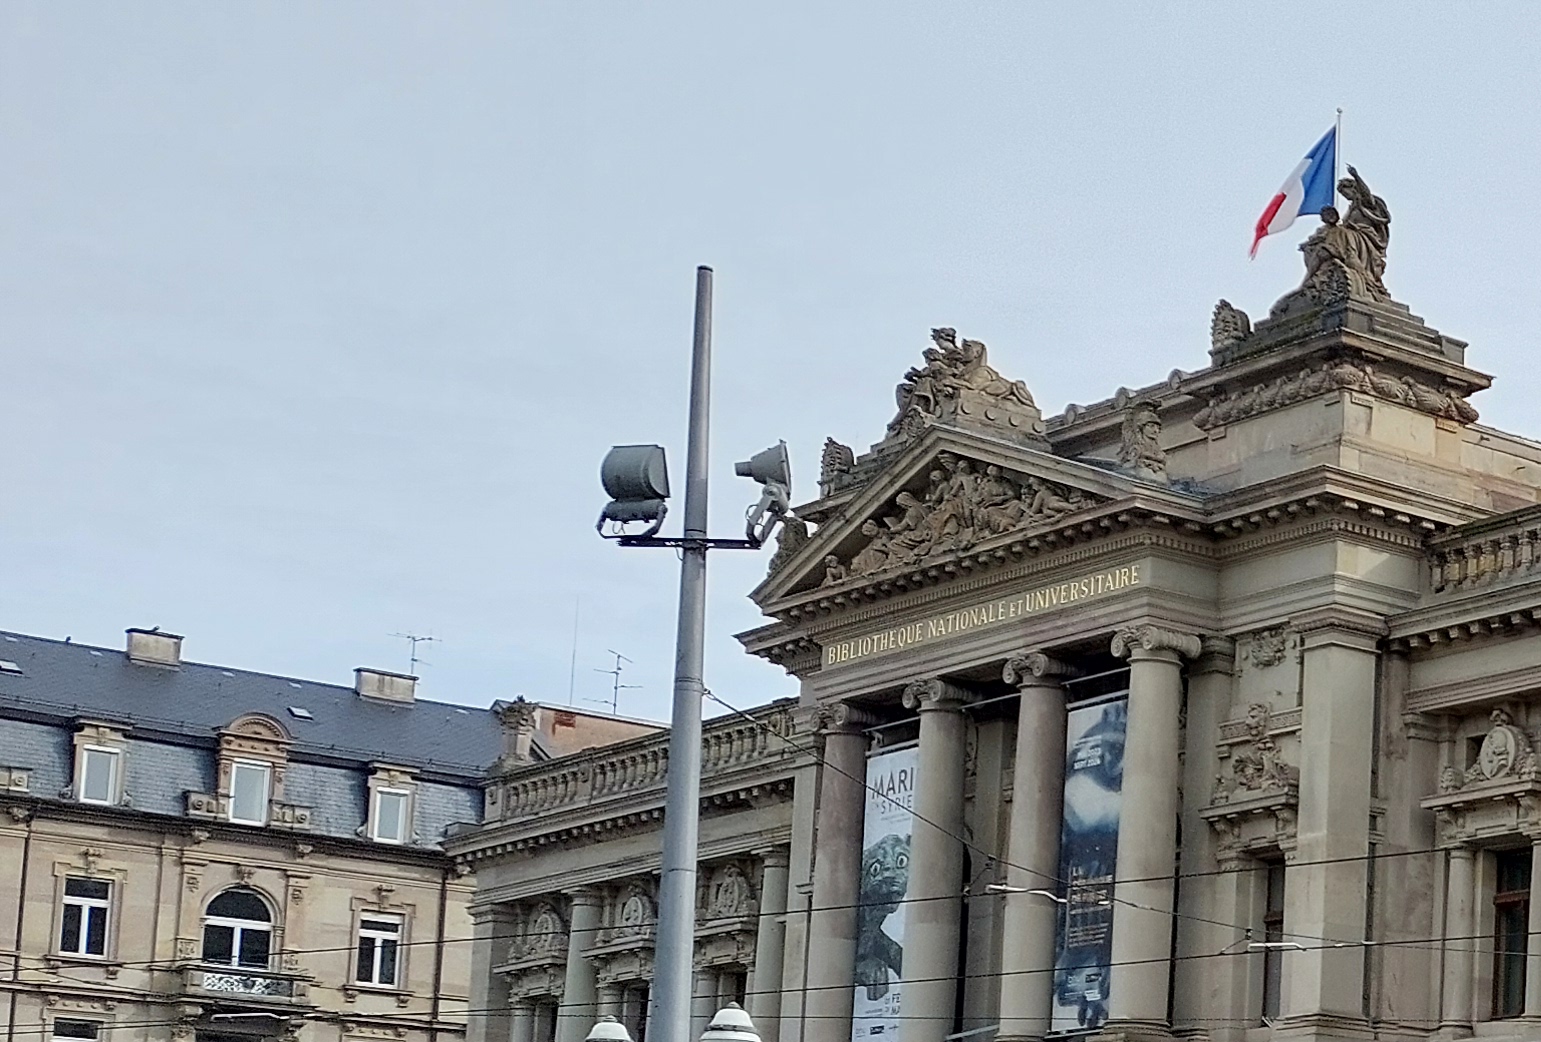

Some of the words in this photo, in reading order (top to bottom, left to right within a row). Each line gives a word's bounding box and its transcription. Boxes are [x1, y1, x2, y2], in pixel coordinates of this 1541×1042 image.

[927, 601, 1006, 638] NATIONALE
[1009, 600, 1023, 617] ET
[1026, 564, 1140, 612] UNIVERSITAIRE
[871, 766, 914, 800] MARI
